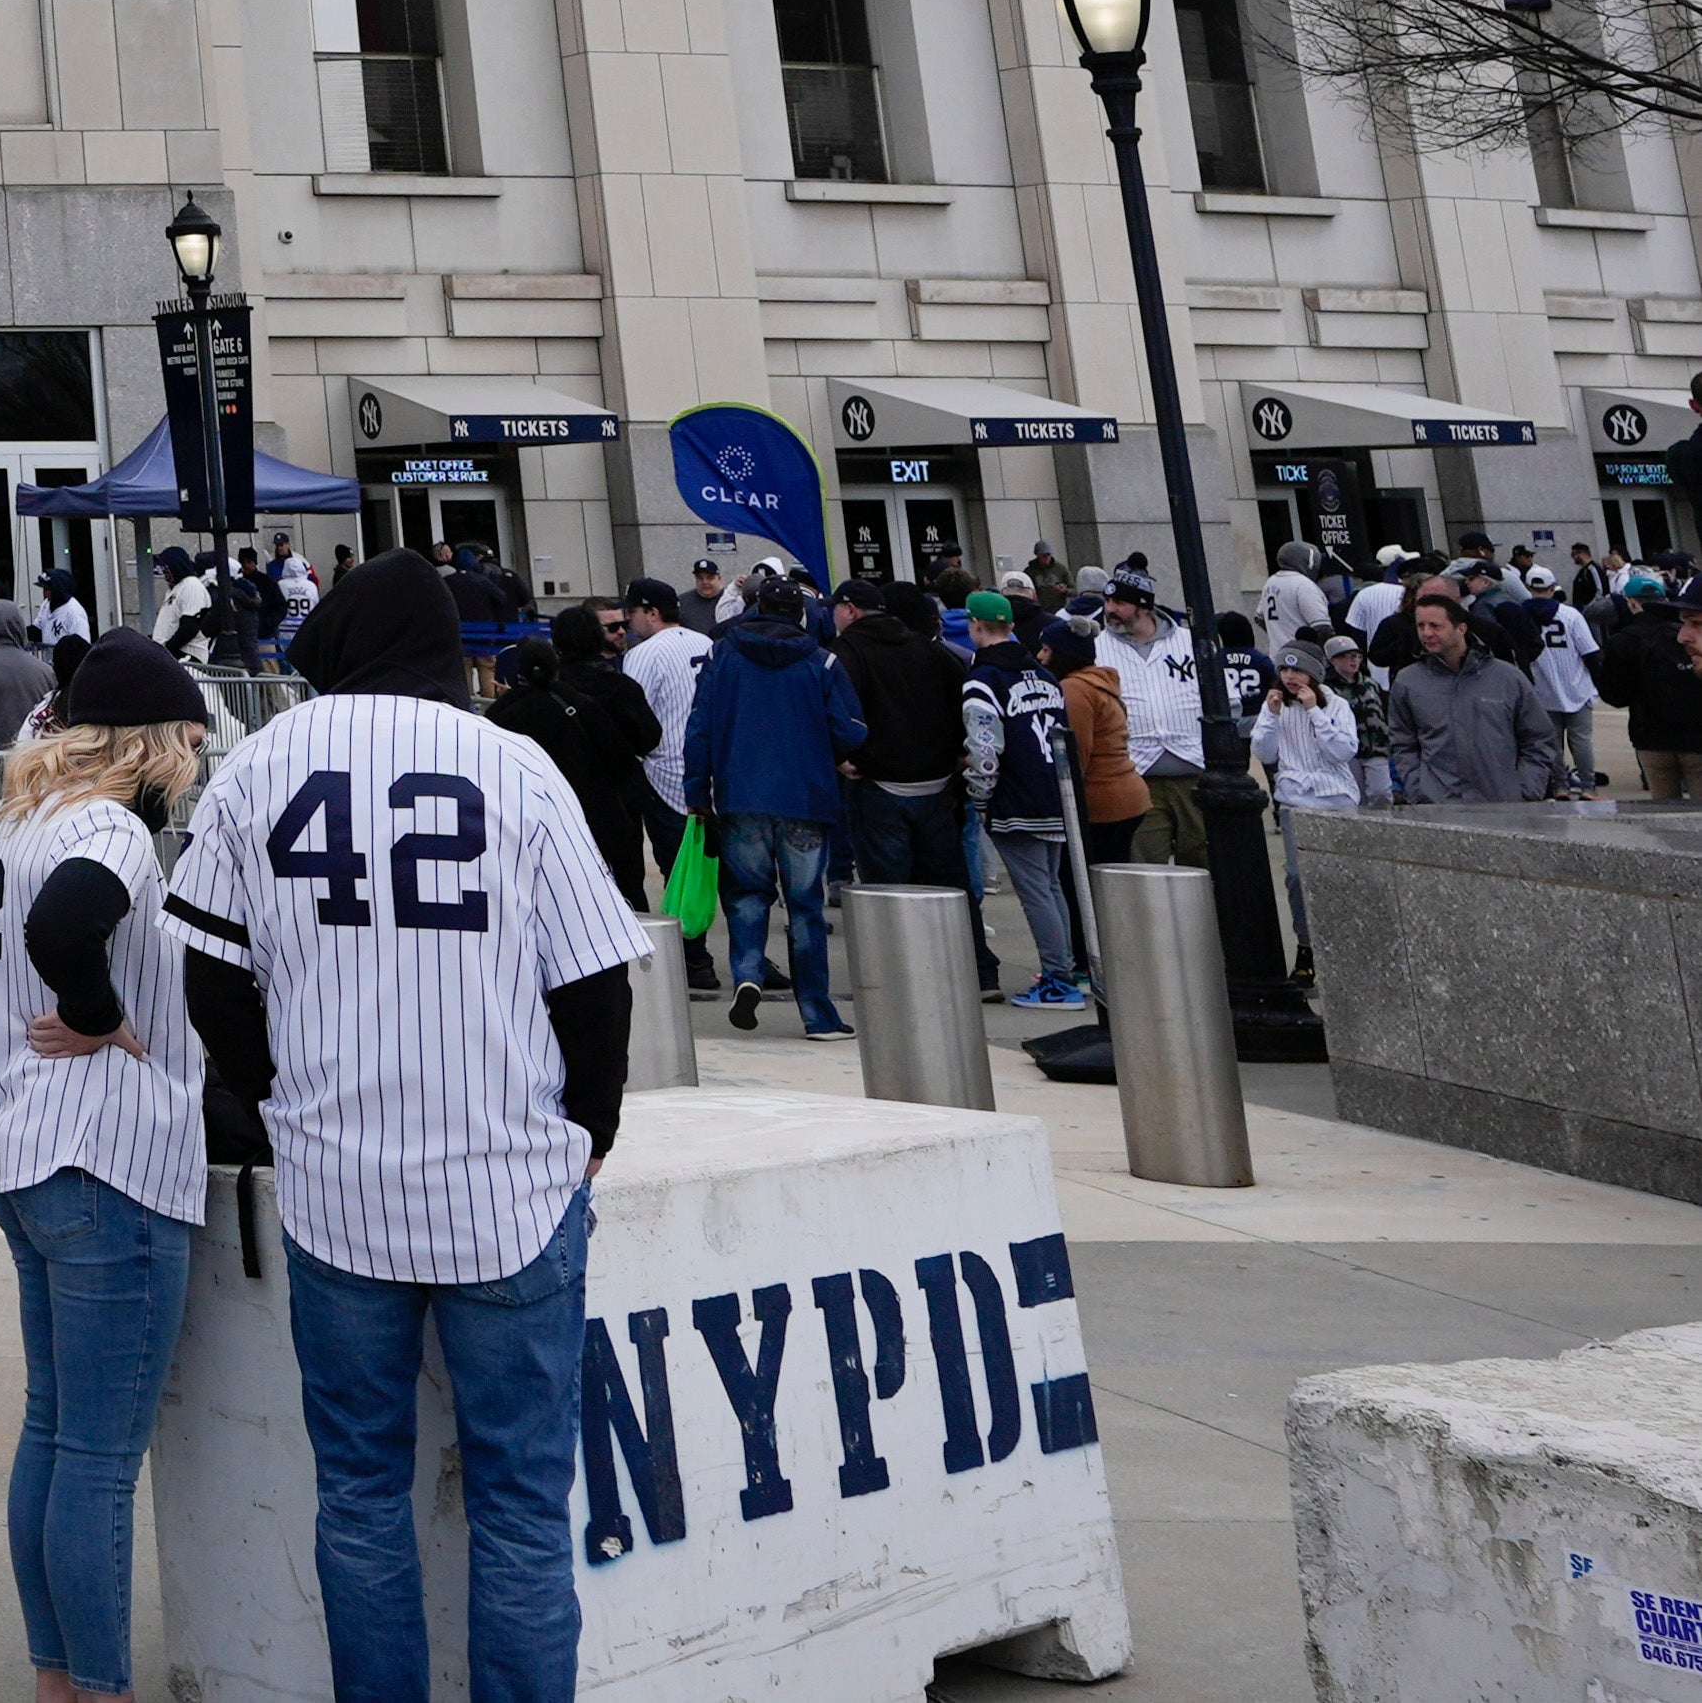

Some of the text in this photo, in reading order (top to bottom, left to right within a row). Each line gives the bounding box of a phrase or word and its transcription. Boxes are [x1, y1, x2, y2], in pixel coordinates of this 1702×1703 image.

[155, 292, 247, 315] YANKEE STADIUM
[213, 337, 243, 355] GATE 6
[362, 399, 380, 433] NY
[847, 400, 871, 435] NY
[1258, 402, 1287, 436] NY
[1609, 409, 1642, 441] NY
[454, 419, 617, 437] NY TICKETS NY
[974, 422, 1115, 439] NY TICKETS NY
[1448, 424, 1500, 441] TICKETS
[391, 470, 489, 483] CUSTOMER SERVICE
[405, 459, 474, 471] TICKET OFFICE
[890, 460, 929, 483] EXIT
[701, 485, 779, 510] CLEAR
[1319, 514, 1347, 529] TICKET
[1321, 530, 1352, 545] OFFICE
[287, 598, 311, 617] 99
[1267, 595, 1279, 621] 2
[1164, 654, 1196, 682] NY
[265, 770, 489, 933] 42
[579, 1250, 1022, 1567] NYPD
[1630, 1590, 1657, 1612] SE
